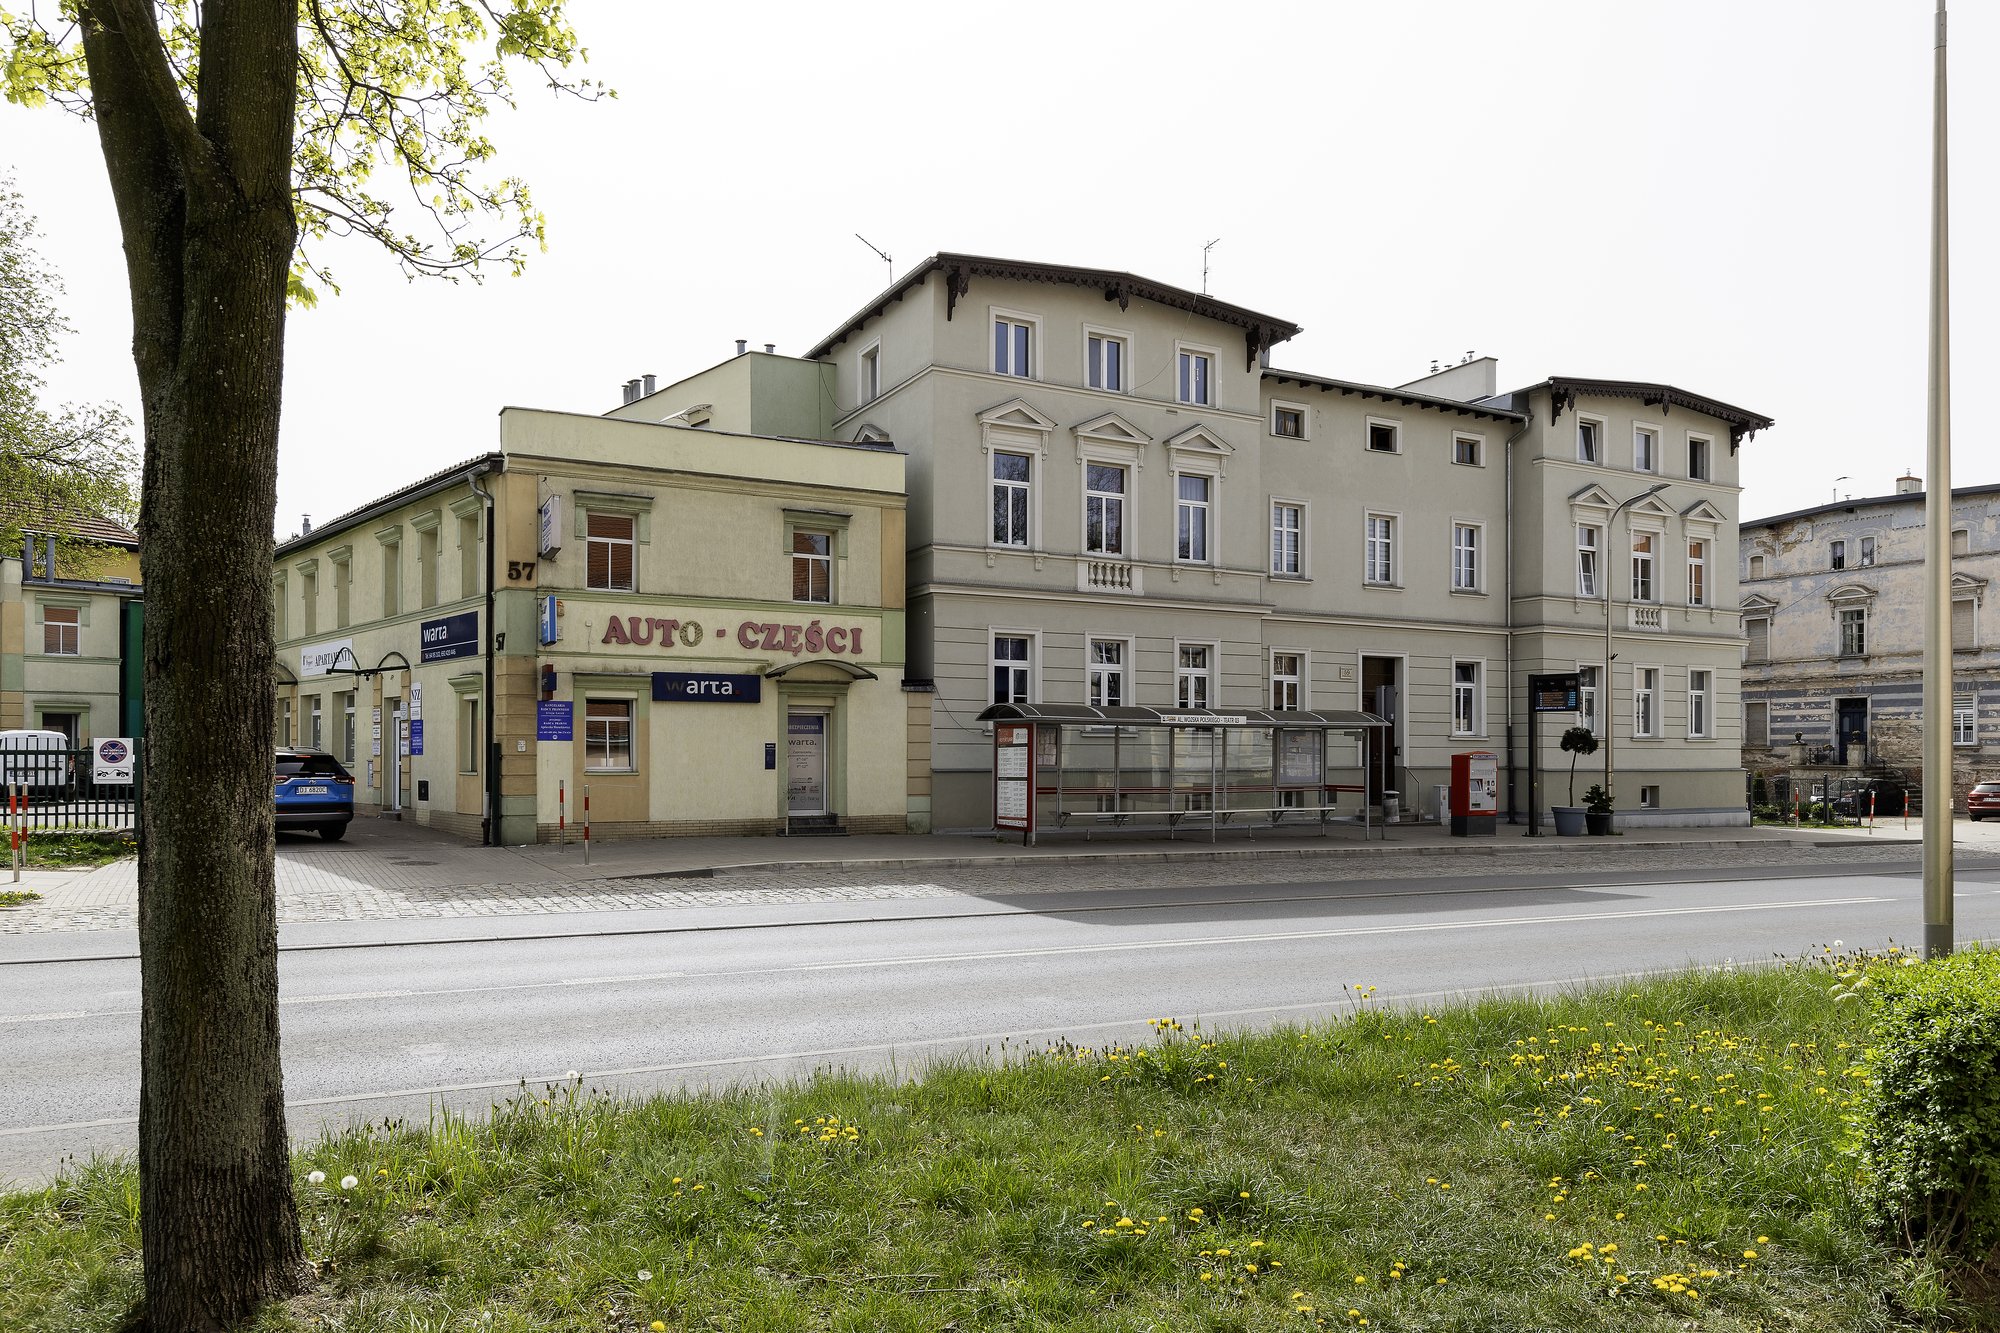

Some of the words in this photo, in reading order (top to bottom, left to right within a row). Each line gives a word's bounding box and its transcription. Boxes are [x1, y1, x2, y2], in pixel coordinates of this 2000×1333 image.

[508, 561, 536, 581] 57
[495, 632, 505, 652] 57
[601, 615, 703, 647] AUTO
[737, 620, 863, 657] CZĘŚCI
